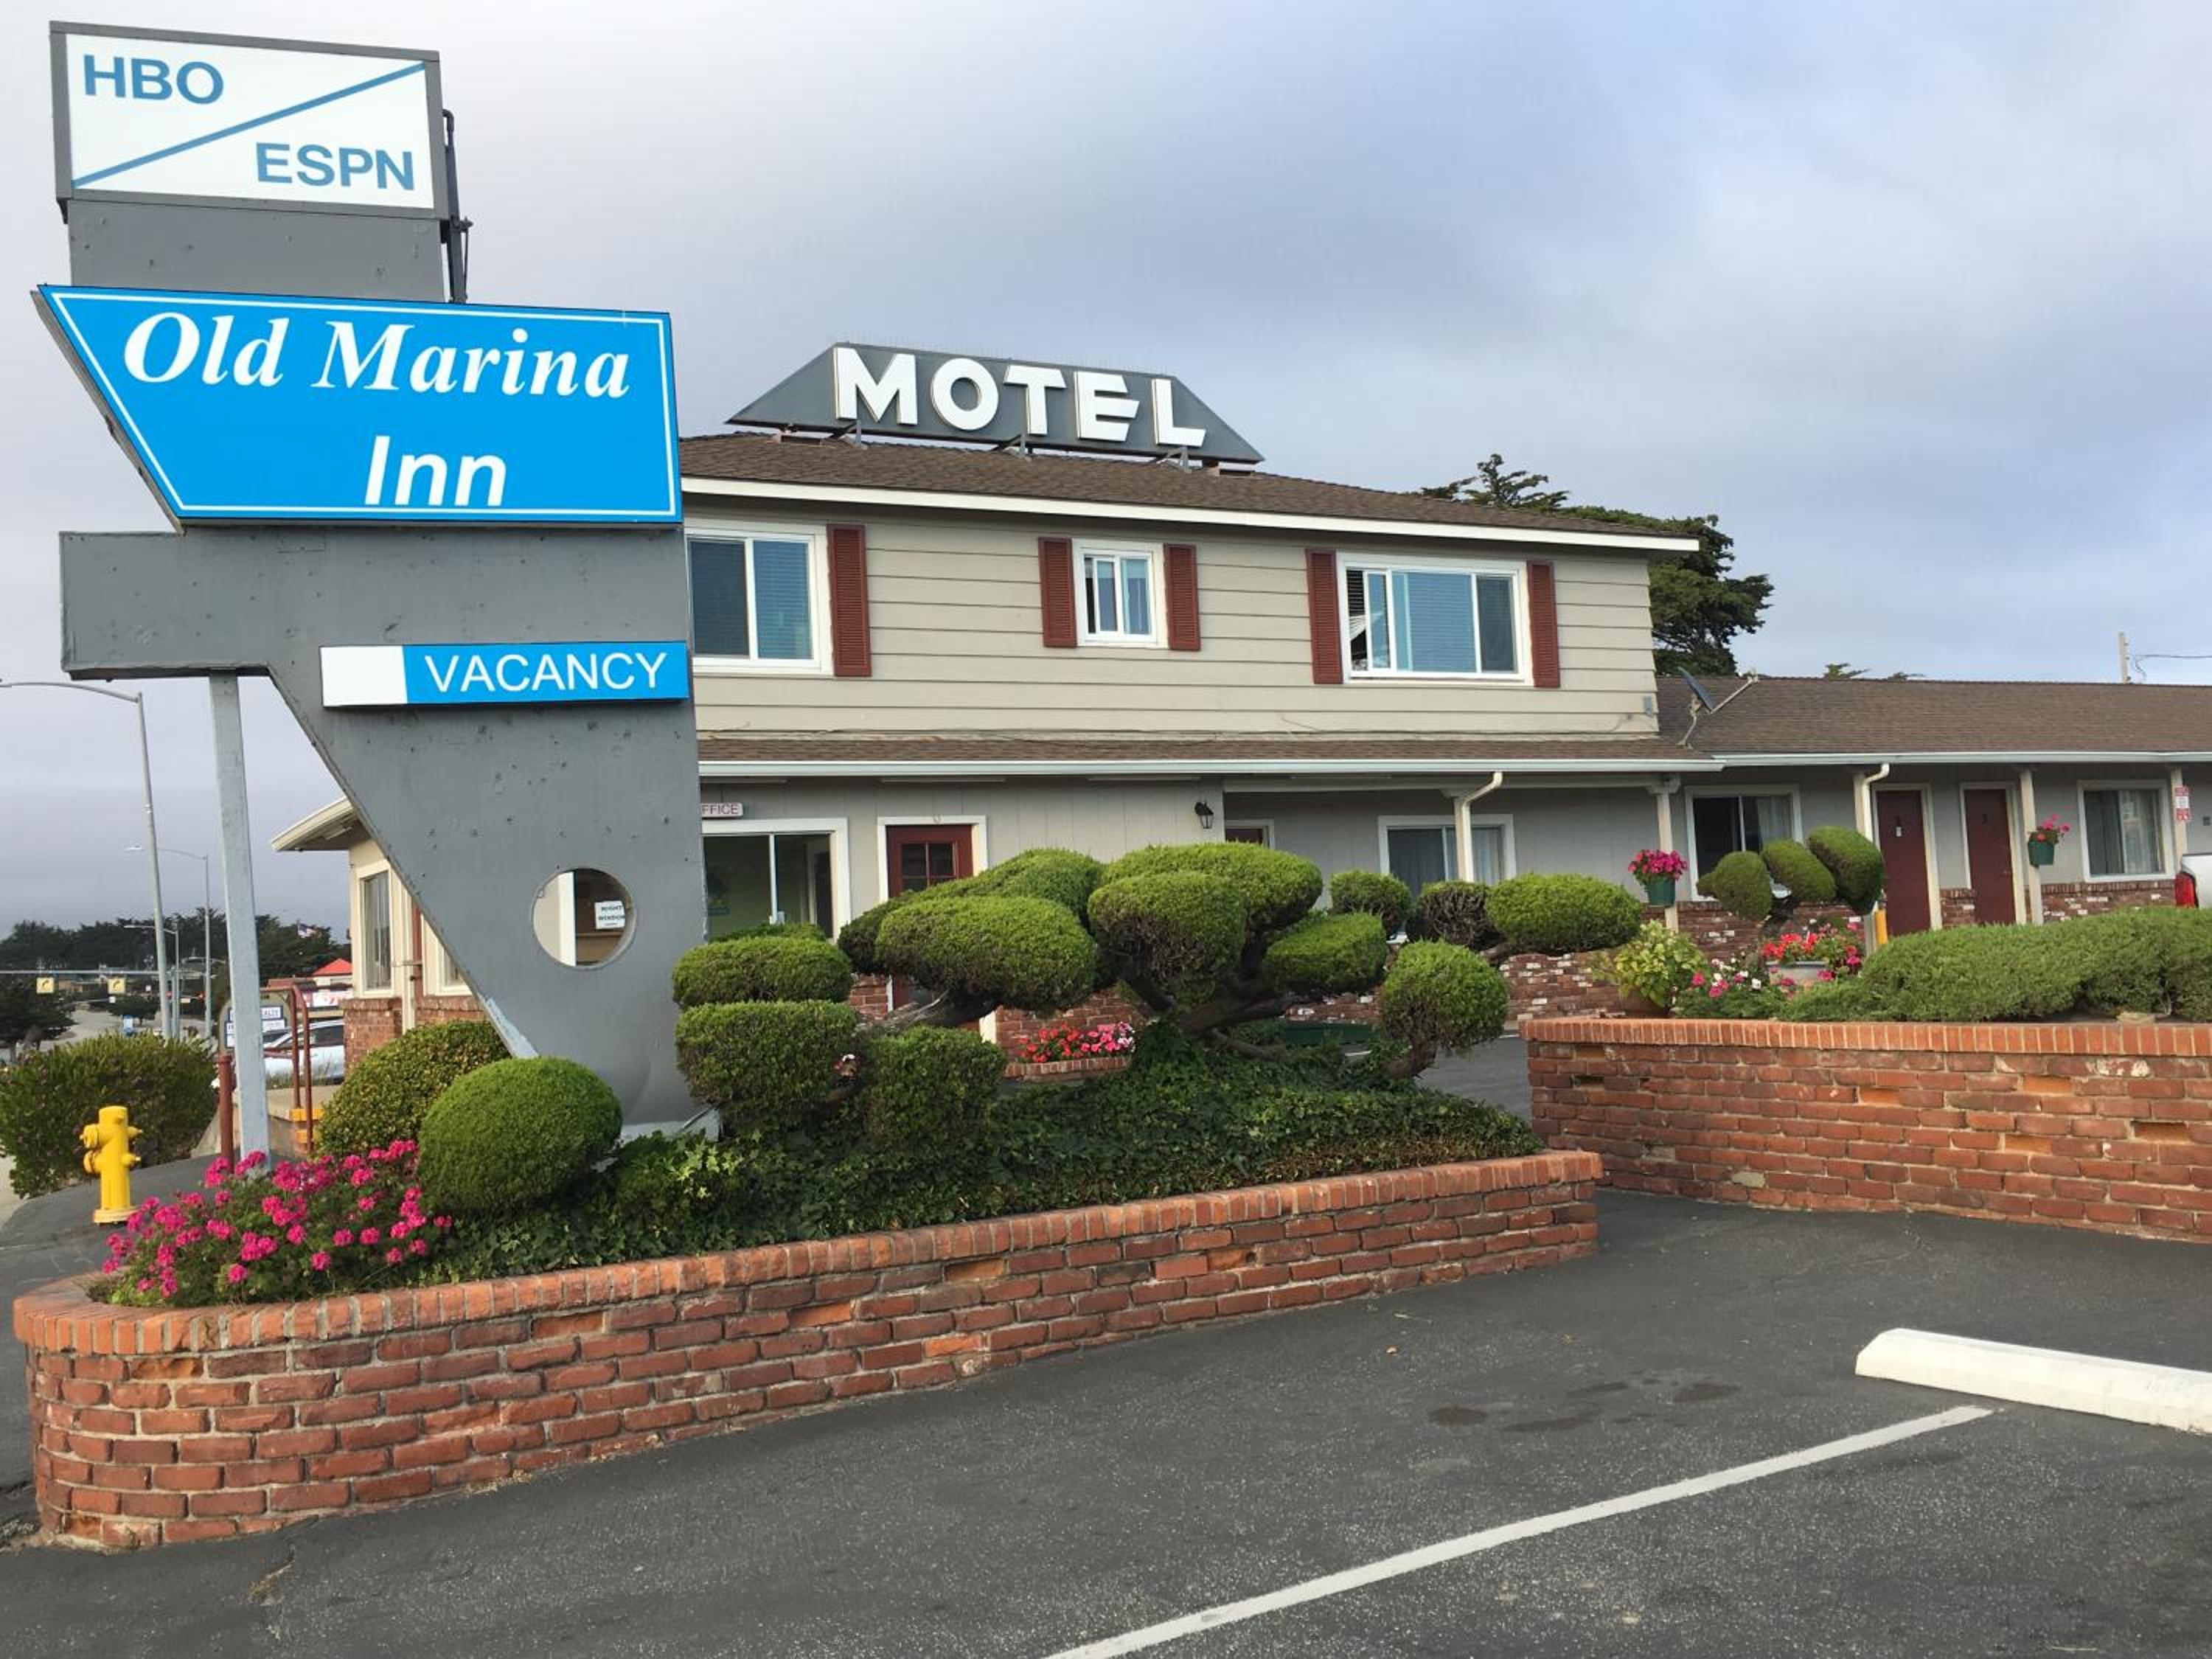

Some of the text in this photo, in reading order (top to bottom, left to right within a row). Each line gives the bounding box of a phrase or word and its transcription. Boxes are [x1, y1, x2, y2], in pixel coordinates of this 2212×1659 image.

[83, 54, 224, 105] HBO
[256, 142, 414, 190] ESPN
[125, 311, 630, 398] Old Marina
[833, 347, 1206, 447] MOTEL
[364, 435, 507, 507] Inn
[425, 653, 667, 692] VACANCY
[701, 804, 739, 815] FFICE
